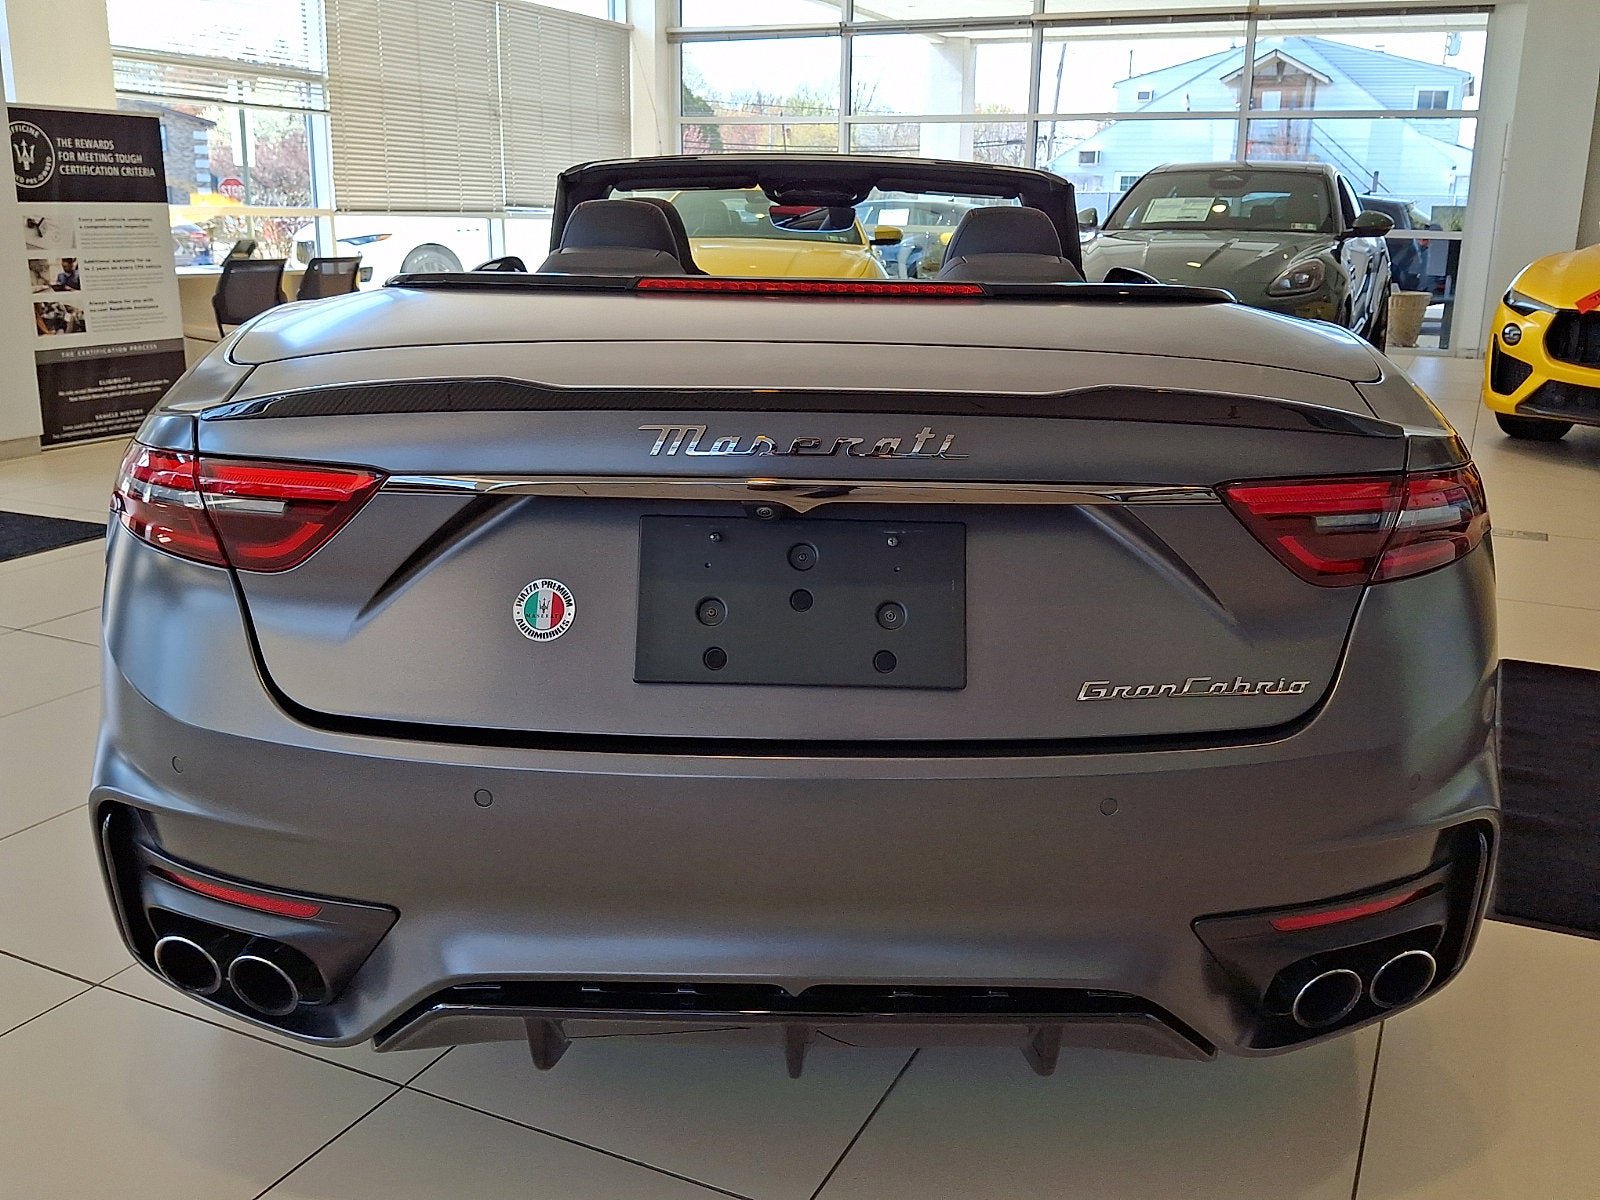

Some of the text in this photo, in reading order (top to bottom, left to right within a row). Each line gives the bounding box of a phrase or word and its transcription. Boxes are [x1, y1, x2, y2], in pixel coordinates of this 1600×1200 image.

[56, 137, 114, 150] THE REWARDS
[58, 151, 142, 164] FOR MEETING TOUGH
[60, 165, 156, 177] CERTIFICATION CRITERIA
[638, 424, 968, 459] Maserati
[515, 580, 574, 607] PIAZZA PREMIUM
[515, 618, 570, 639] AUTOMOBILES
[1076, 676, 1311, 701] GranCabrio
